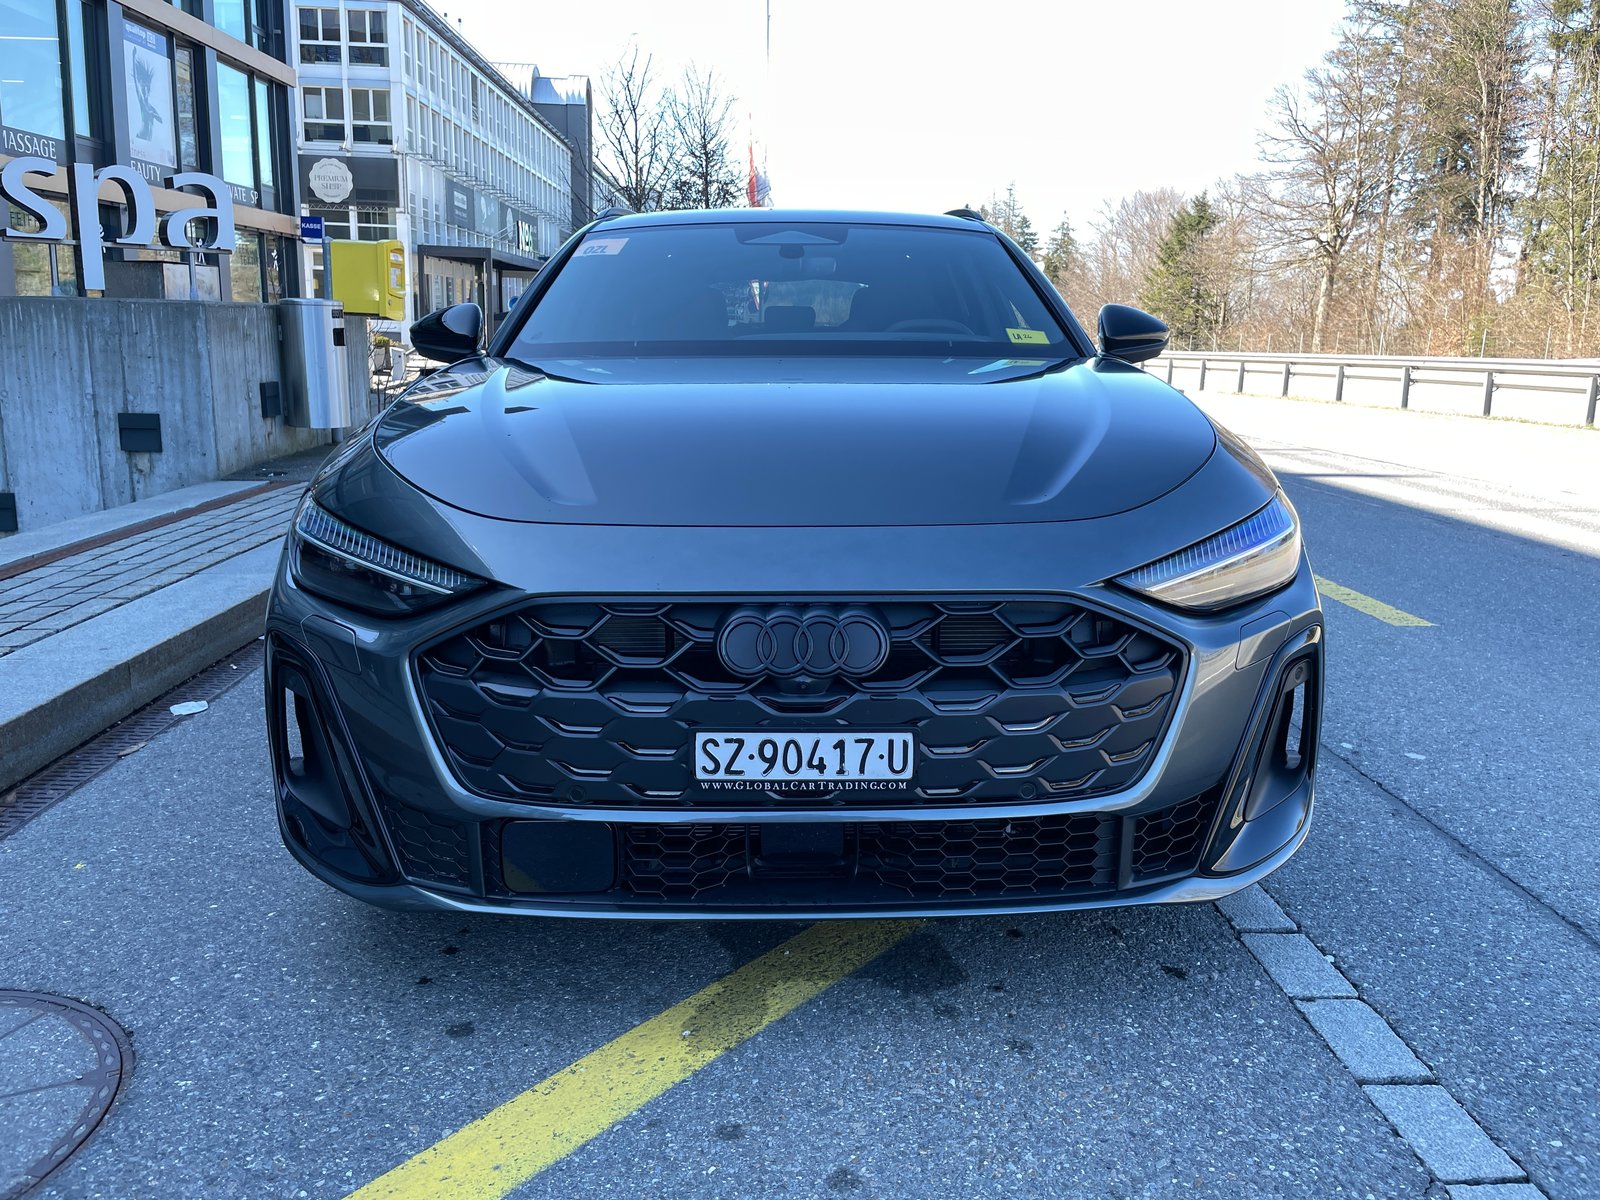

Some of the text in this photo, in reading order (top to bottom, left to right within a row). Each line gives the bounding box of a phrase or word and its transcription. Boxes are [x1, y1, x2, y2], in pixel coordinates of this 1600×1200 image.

[130, 160, 161, 182] EAUTY
[314, 174, 348, 183] PREMIUM
[225, 184, 259, 205] VATE SP
[1, 156, 235, 291] spa
[301, 222, 322, 230] KASSE
[700, 781, 908, 791] WWW.GLOBALCARTRADING.COM
